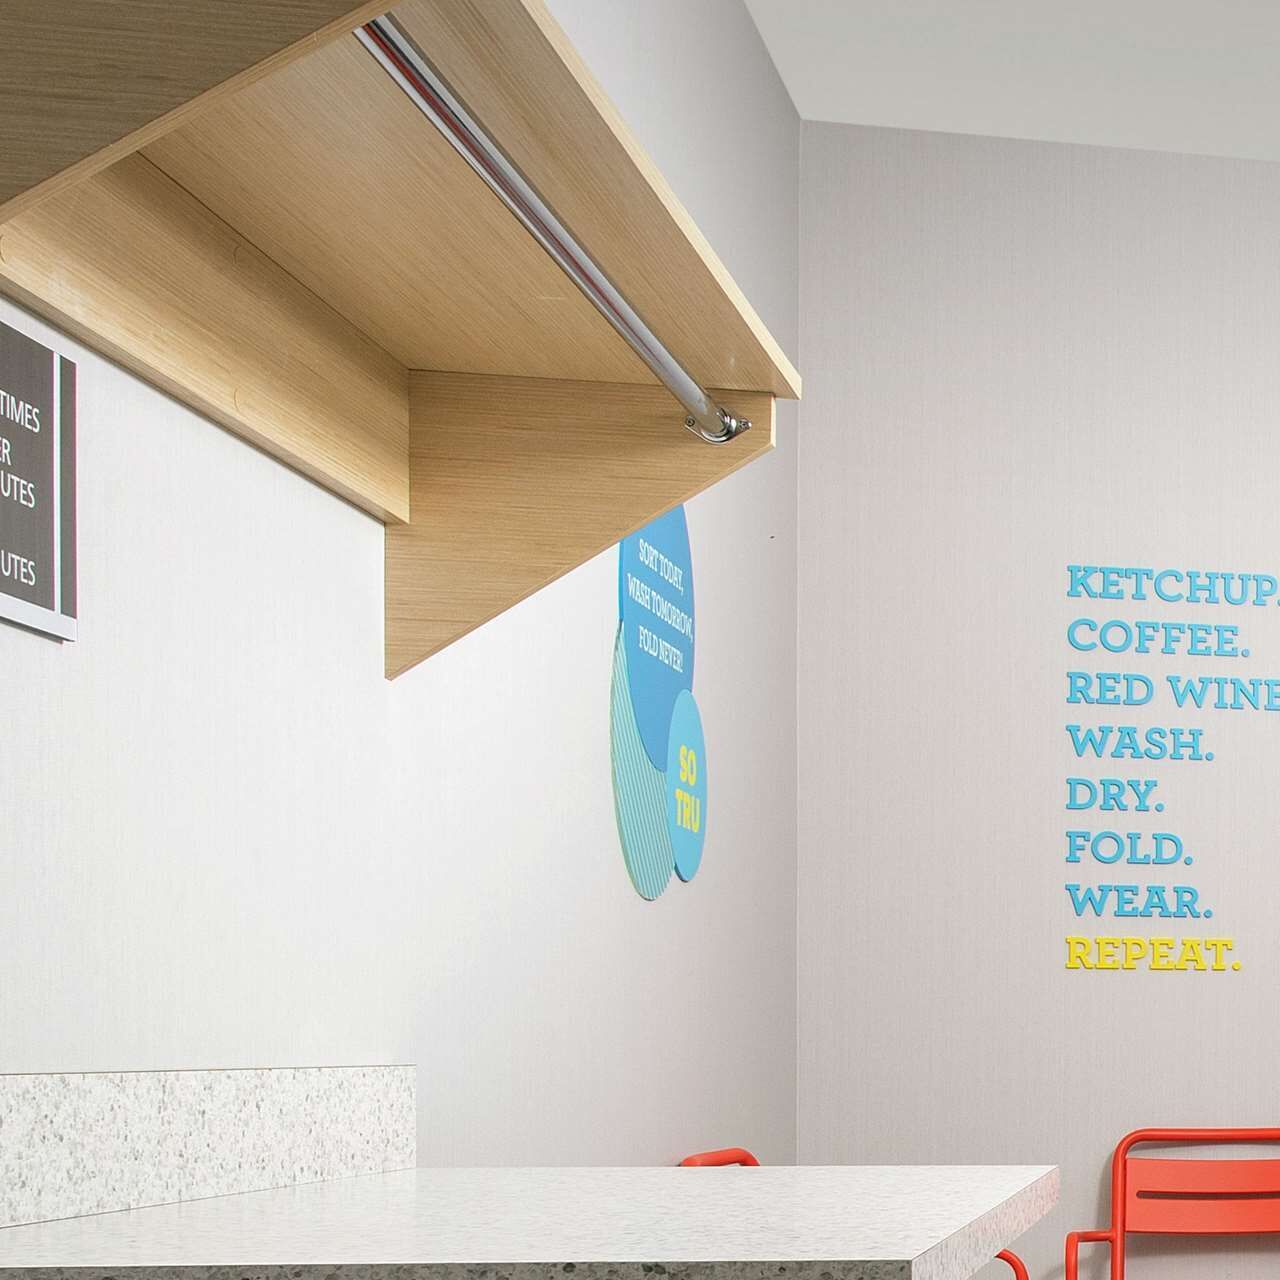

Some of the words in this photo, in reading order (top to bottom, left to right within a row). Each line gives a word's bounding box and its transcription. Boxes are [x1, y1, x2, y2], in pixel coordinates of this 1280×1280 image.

[0, 389, 40, 433] TIMES
[638, 538, 658, 573] SORT
[627, 573, 651, 610] WASH
[638, 625, 659, 657] FOLD
[1067, 618, 1250, 658] COFFEE.
[1066, 671, 1155, 706] RED
[1066, 724, 1215, 761] WASH.
[679, 744, 697, 786] SO
[675, 788, 700, 833] TRU
[1066, 777, 1165, 812] DRY.
[1065, 830, 1193, 866] FOLD.
[1065, 883, 1213, 919] WEAR.
[1065, 935, 1242, 971] REPEAT.
